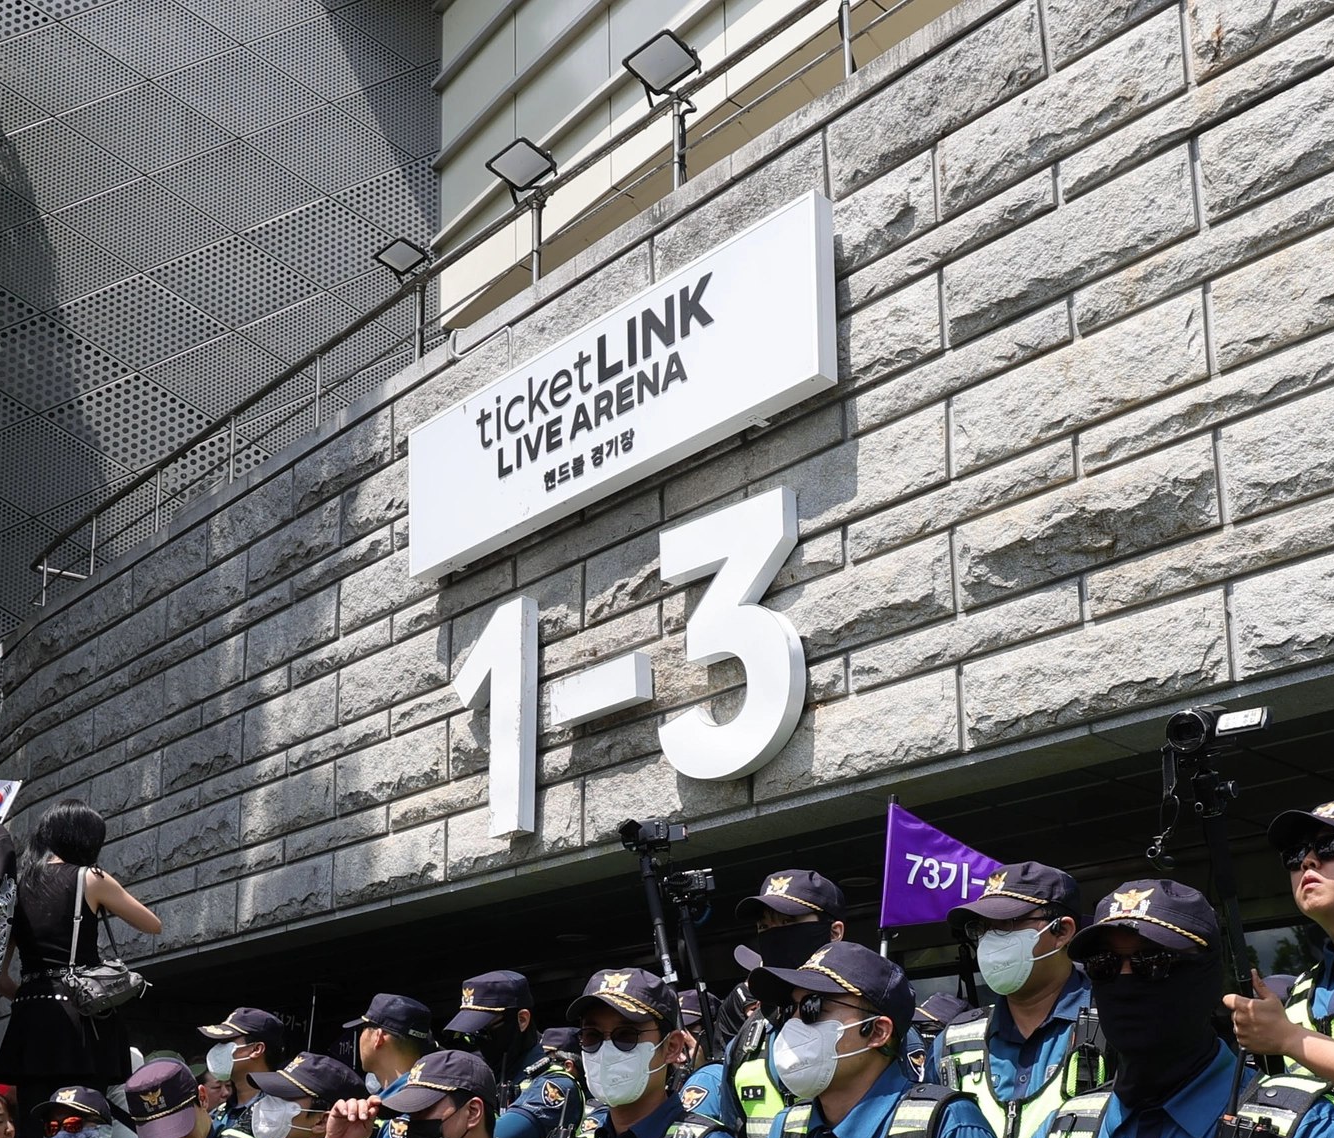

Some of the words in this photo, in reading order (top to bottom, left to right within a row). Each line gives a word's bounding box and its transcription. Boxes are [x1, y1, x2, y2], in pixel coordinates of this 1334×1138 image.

[476, 272, 714, 448] ticketLINK
[498, 415, 563, 478] LIVE
[570, 351, 687, 441] ARENA
[544, 454, 585, 491] 핸드볼
[591, 428, 634, 467] 경기장
[453, 485, 806, 838] 1-3
[906, 853, 985, 899] 73기-
